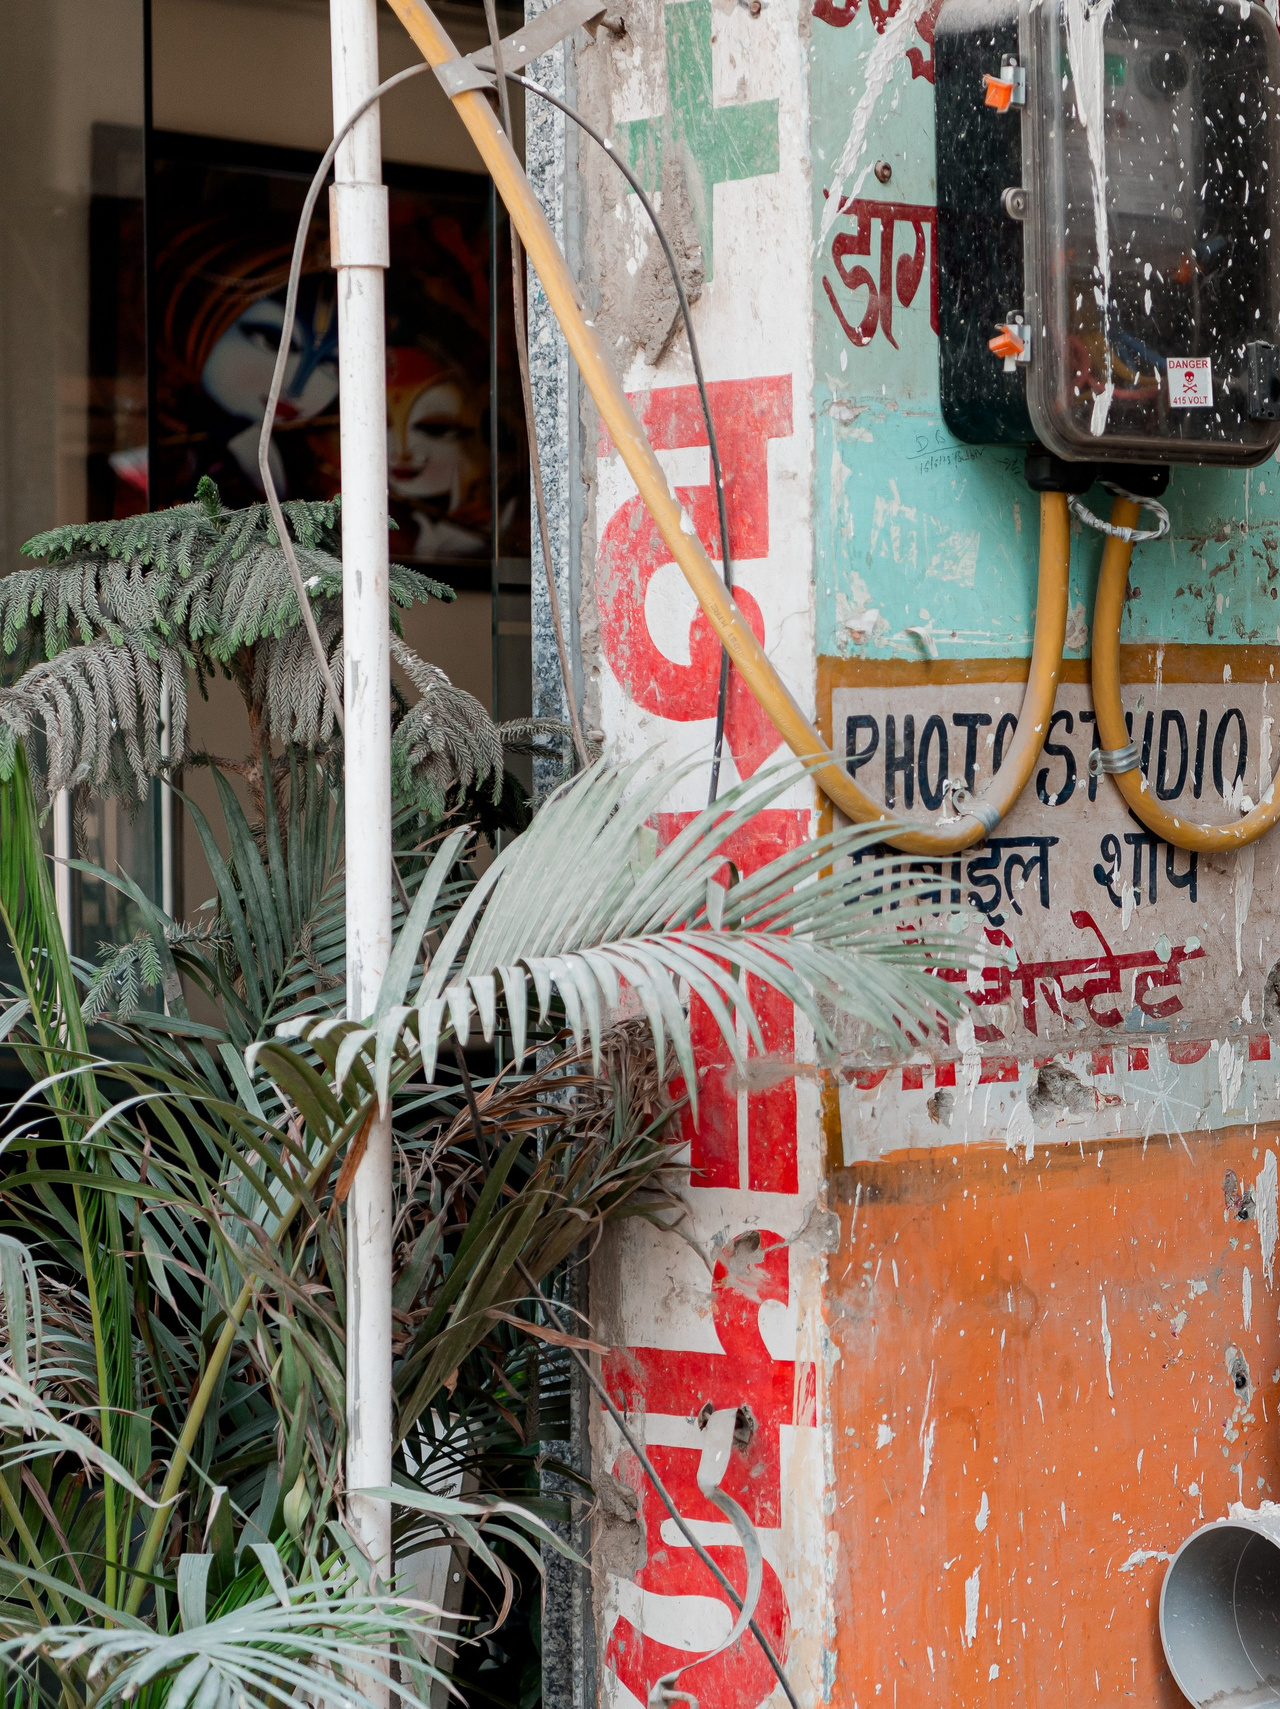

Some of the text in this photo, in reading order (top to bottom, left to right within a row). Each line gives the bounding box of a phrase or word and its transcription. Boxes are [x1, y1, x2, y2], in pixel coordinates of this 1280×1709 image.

[1168, 359, 1209, 369] DANGER
[1173, 396, 1208, 405] 415 VOLT
